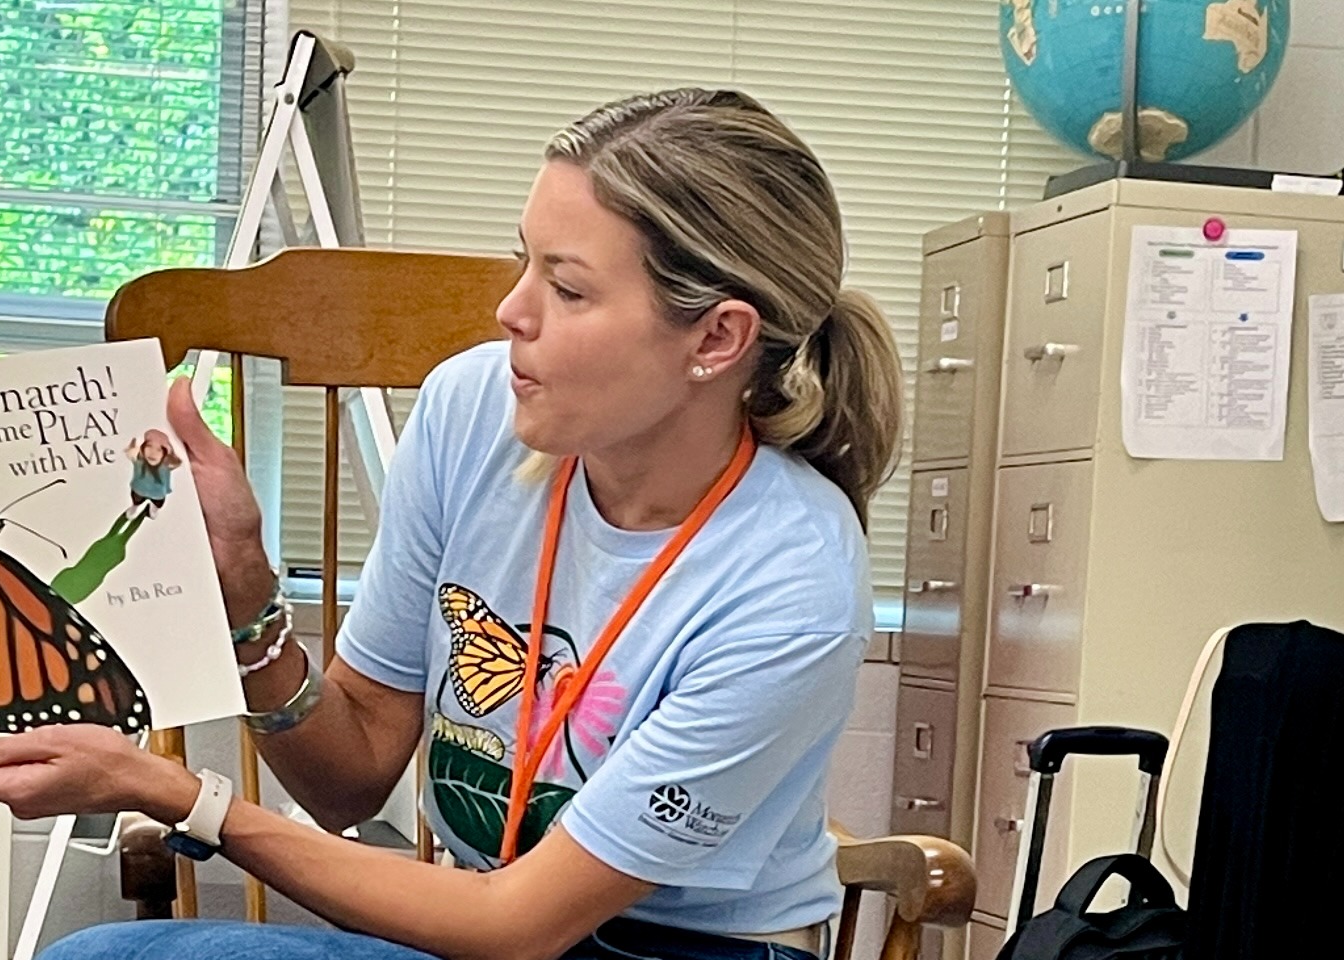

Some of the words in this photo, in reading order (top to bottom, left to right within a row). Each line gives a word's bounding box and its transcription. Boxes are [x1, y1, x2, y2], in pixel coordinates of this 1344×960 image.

[34, 408, 120, 446] PLAY
[8, 447, 68, 477] with
[77, 442, 117, 469] Me
[107, 590, 124, 606] by
[130, 586, 151, 602] Ba
[154, 584, 183, 600] Rea
